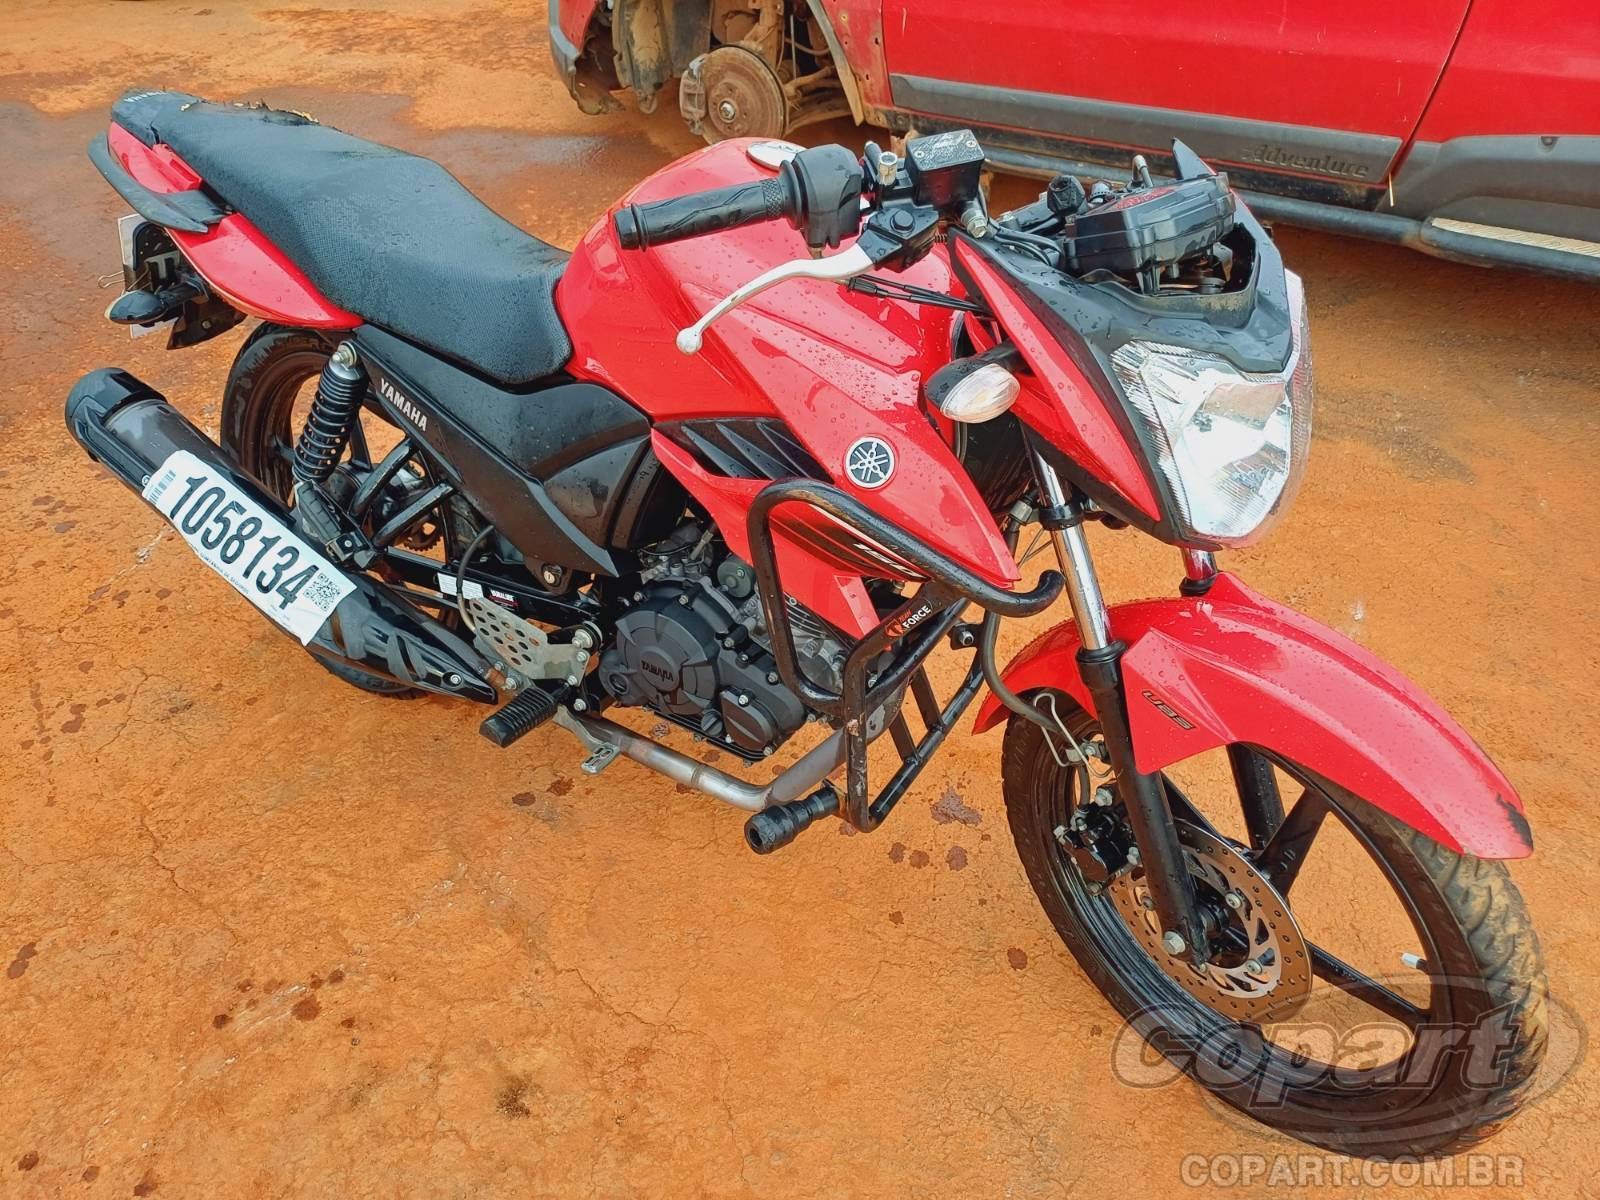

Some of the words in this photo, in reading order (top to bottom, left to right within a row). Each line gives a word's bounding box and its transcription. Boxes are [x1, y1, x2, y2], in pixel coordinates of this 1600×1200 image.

[381, 377, 428, 432] YAMAHA
[169, 475, 320, 611] 1058134
[902, 605, 931, 629] FORCE
